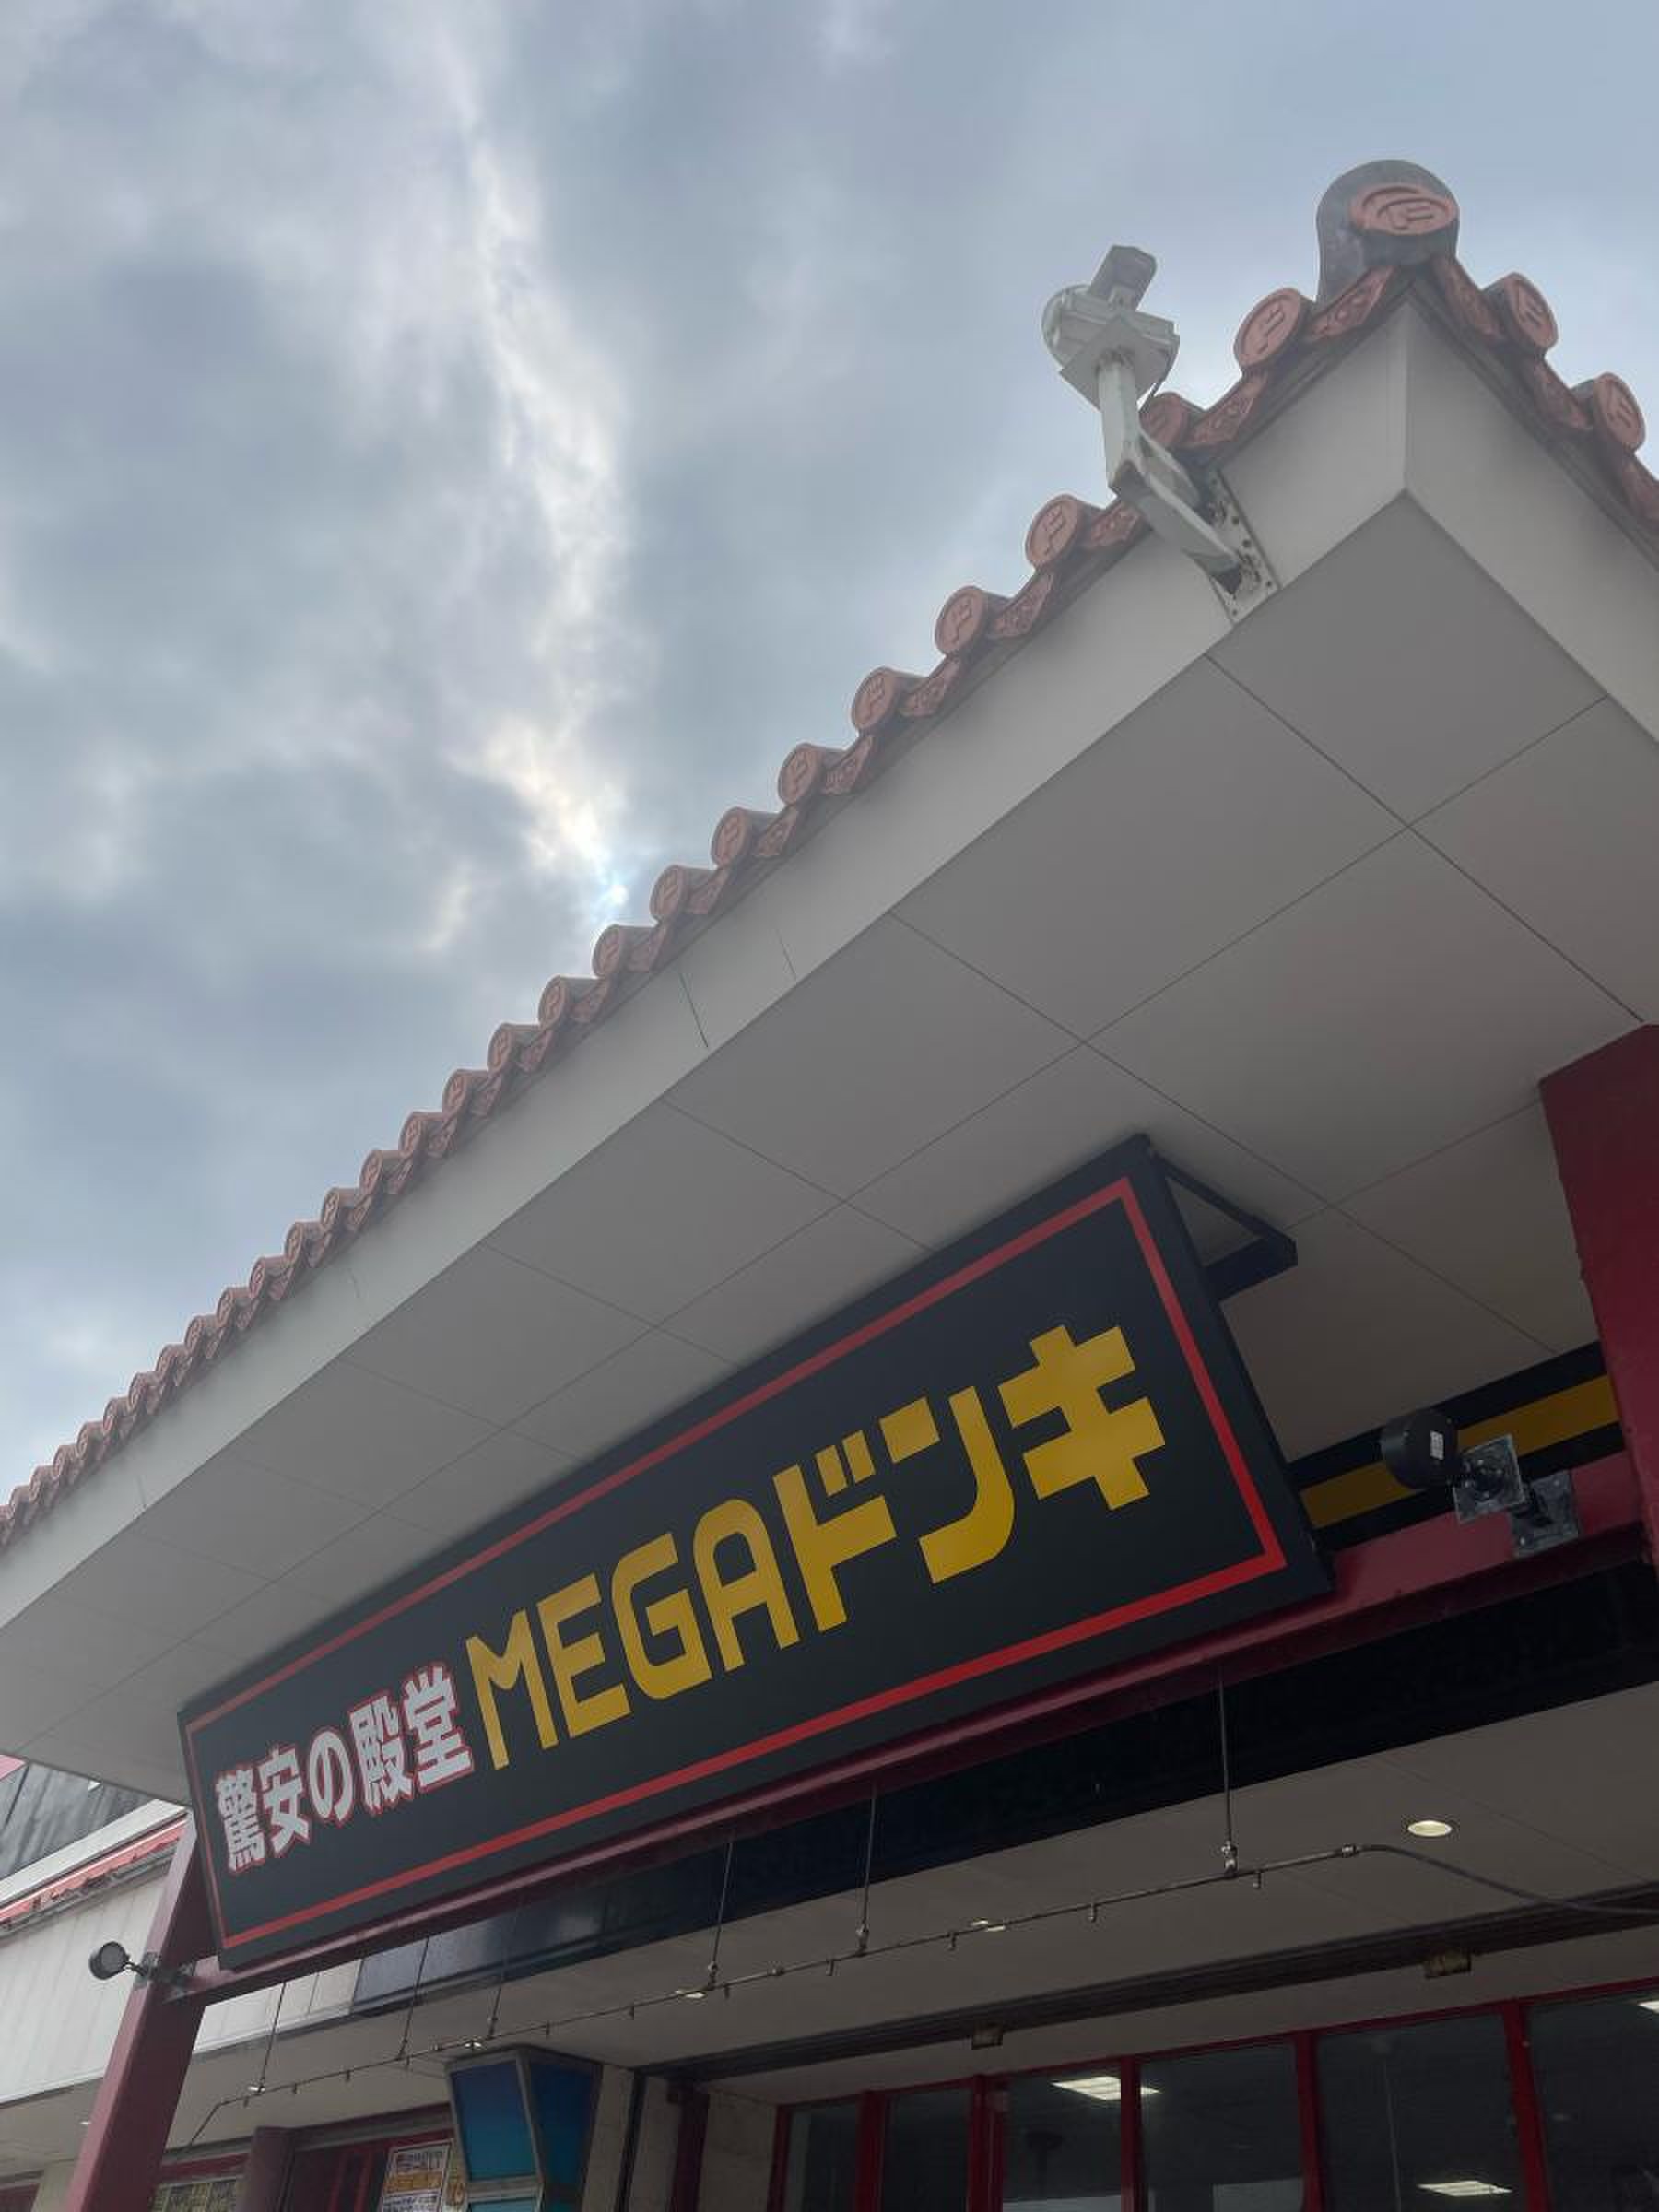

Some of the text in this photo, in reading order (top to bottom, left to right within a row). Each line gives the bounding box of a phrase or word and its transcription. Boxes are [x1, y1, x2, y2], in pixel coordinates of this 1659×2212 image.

[214, 1324, 1166, 1874] 驚安の殿堂 MEGAドンキ
